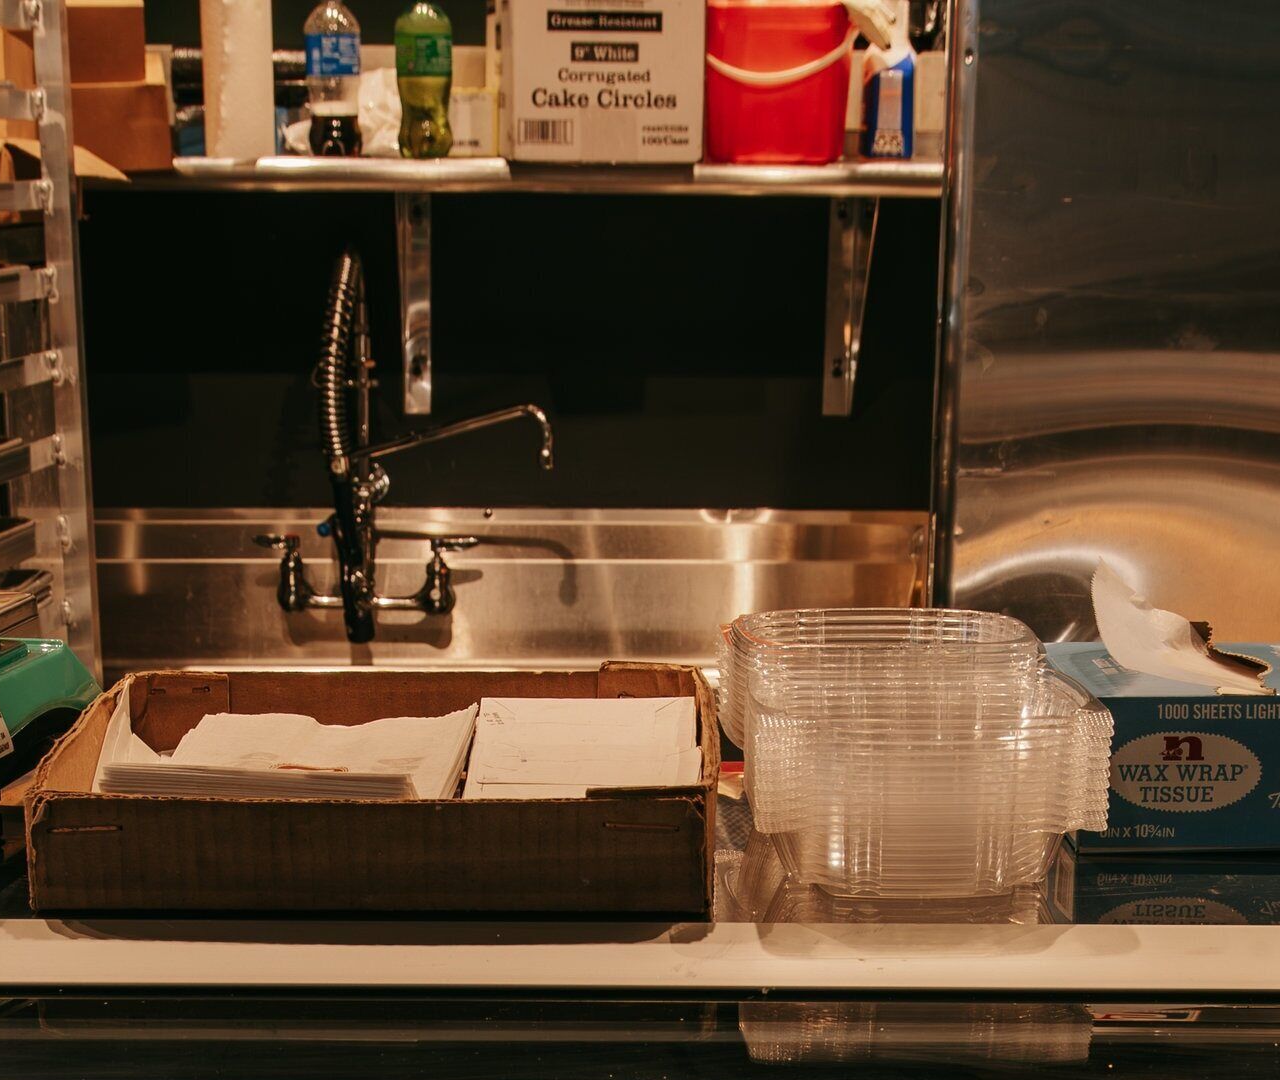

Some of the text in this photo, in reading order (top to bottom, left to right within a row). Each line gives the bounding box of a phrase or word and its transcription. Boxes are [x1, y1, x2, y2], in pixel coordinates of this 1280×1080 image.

[593, 45, 636, 60] White
[557, 67, 651, 85] Corrugated
[531, 87, 677, 109] Cake Circles
[1157, 704, 1189, 720] 1000
[1193, 704, 1242, 720] SHEETS
[1119, 764, 1173, 782] WAX
[1139, 786, 1215, 803] TISSUE
[1122, 826, 1131, 838] X
